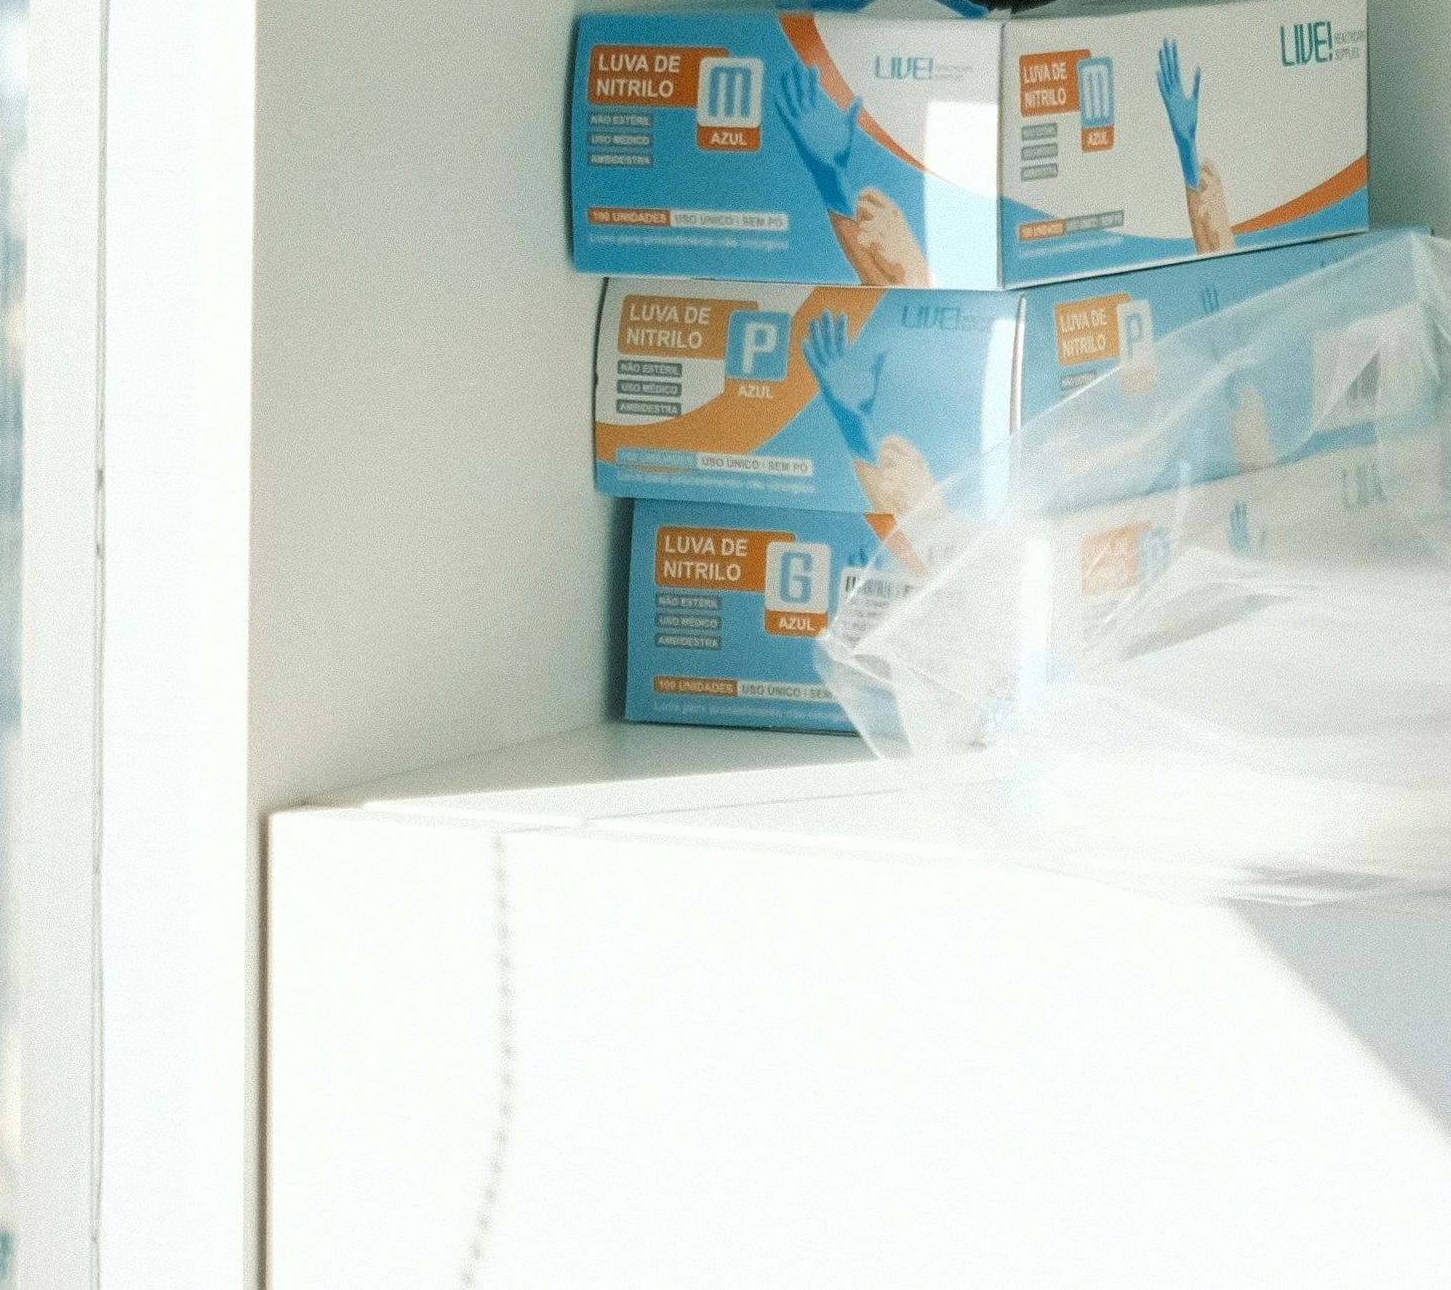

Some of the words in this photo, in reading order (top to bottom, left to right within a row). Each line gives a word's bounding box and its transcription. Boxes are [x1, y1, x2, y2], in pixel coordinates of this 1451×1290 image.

[1279, 20, 1333, 67] LIVE!
[598, 53, 649, 72] LUVA
[655, 55, 681, 73] DE
[874, 54, 934, 81] LIVE!
[1023, 64, 1051, 83] LUVA
[1052, 62, 1068, 80] DE
[596, 77, 675, 99] NITRILO
[1024, 87, 1067, 109] NITRILO
[710, 131, 748, 146] AZUL
[612, 211, 667, 224] UNIDADES
[629, 304, 680, 323] LUVA
[684, 306, 711, 324] DE
[1060, 311, 1090, 333] LUVA
[1091, 307, 1108, 328] DE
[626, 328, 703, 349] NITRILO
[742, 323, 778, 373] P
[1062, 333, 1107, 359] NITRILO
[620, 382, 641, 393] USO
[738, 385, 773, 399] AZUL
[701, 457, 725, 468] USO
[768, 460, 791, 471] SEM
[793, 460, 809, 473] PÓ
[664, 535, 716, 556] LUVA
[721, 537, 748, 557] DE
[663, 560, 742, 582] NITRILO
[780, 551, 813, 604] G
[778, 617, 815, 631] AZUL
[678, 681, 734, 694] UNIDADES
[741, 683, 765, 695] USO
